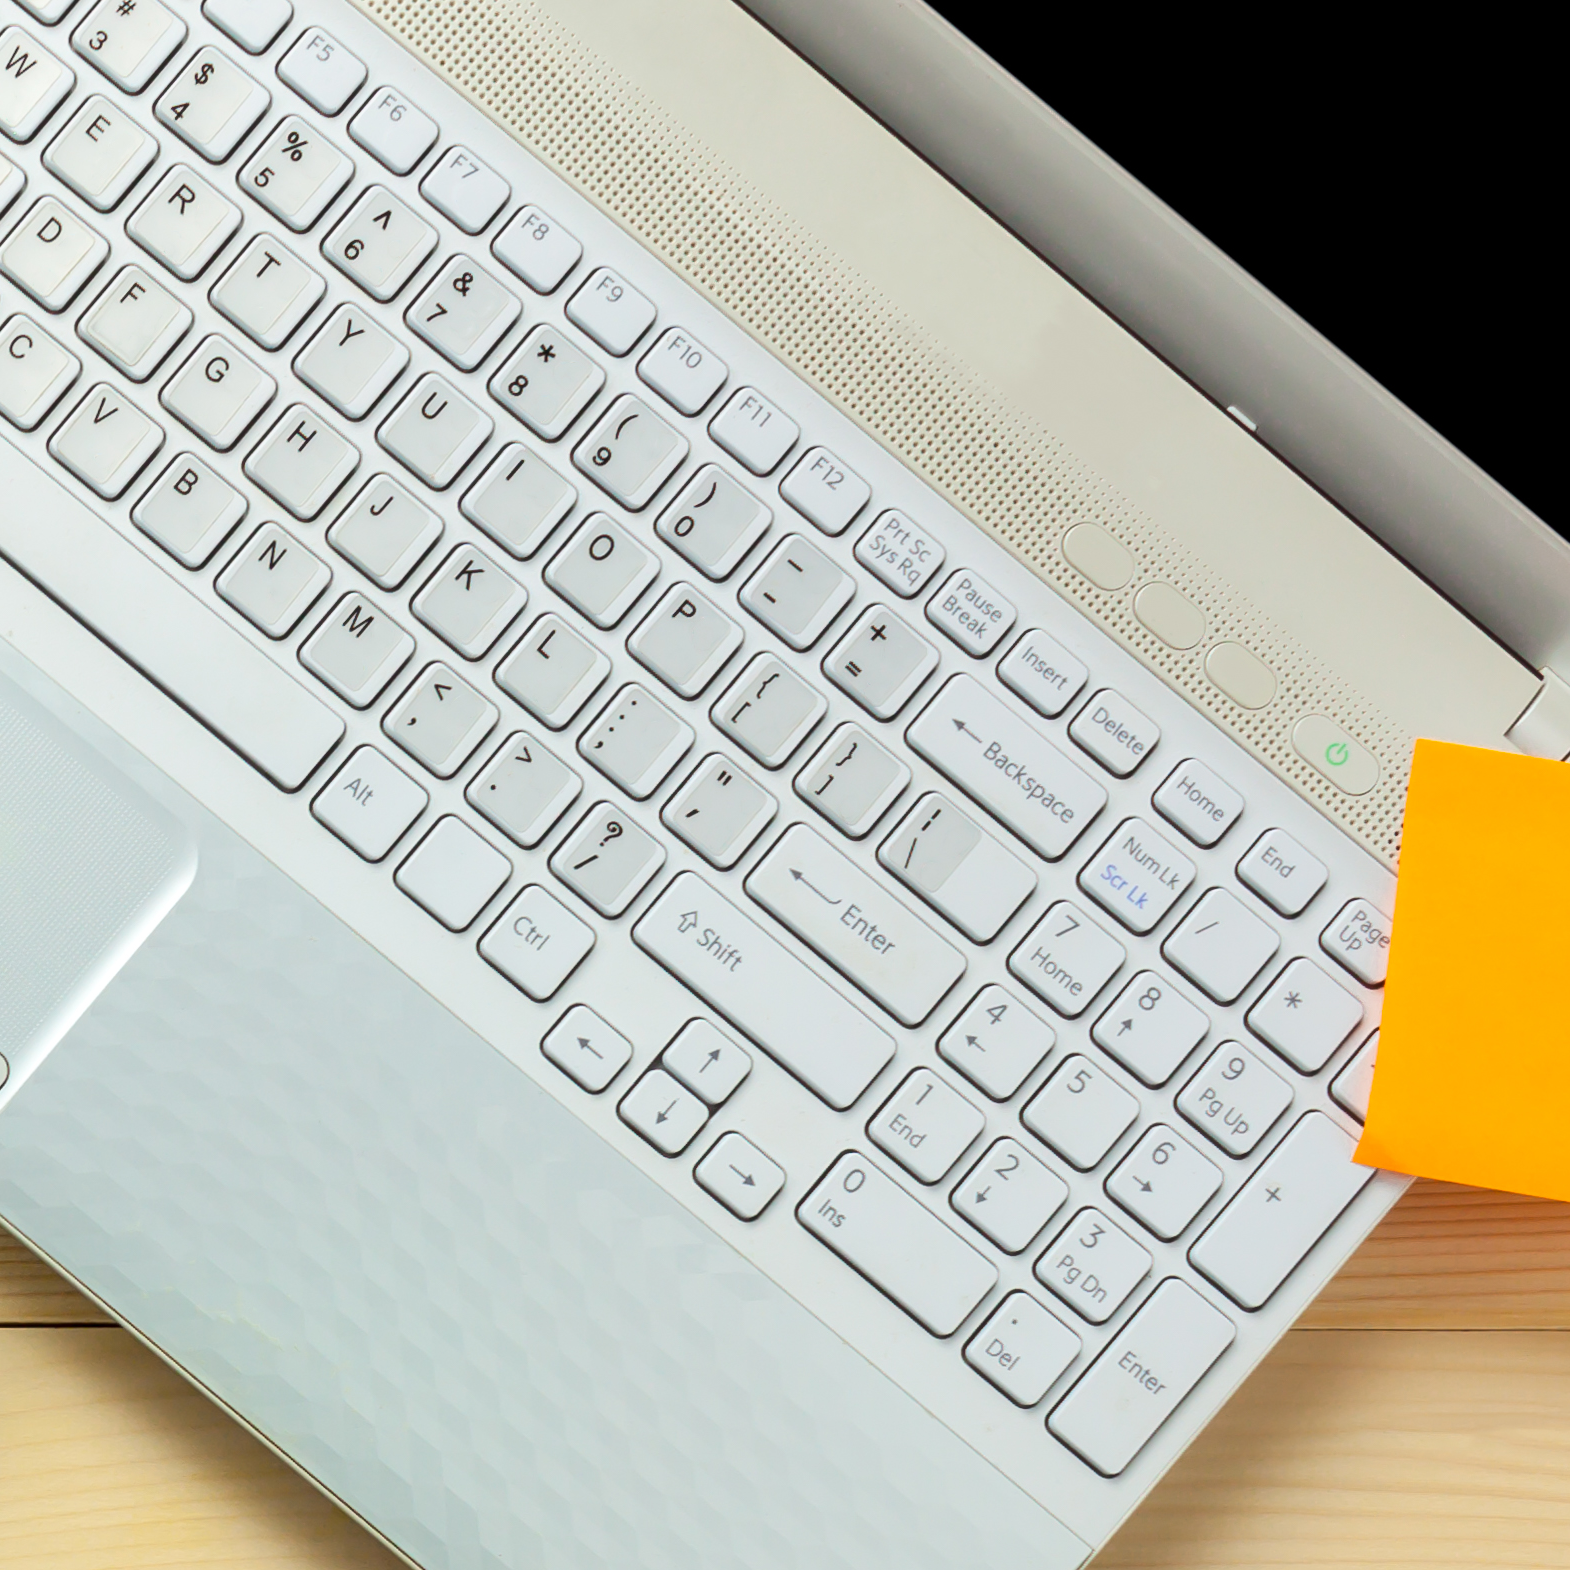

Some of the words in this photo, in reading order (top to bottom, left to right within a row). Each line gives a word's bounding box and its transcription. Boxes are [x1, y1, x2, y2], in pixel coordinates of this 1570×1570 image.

[88, 30, 108, 51] 3
[306, 35, 335, 62] F5
[5, 45, 38, 79] W
[194, 62, 215, 85] $
[170, 102, 190, 121] 4
[378, 95, 407, 122] F6
[85, 114, 111, 142] E
[281, 131, 309, 162] %
[253, 166, 275, 188] 5
[449, 154, 479, 179] F7
[167, 183, 196, 215] R
[36, 216, 63, 244] D
[521, 213, 550, 241] F8
[344, 239, 365, 261] 6
[256, 251, 282, 278] T
[119, 282, 146, 304] F
[452, 271, 474, 297] &
[596, 274, 624, 303] F9
[426, 302, 448, 323] 7
[8, 334, 33, 359] C
[338, 318, 366, 347] Y
[667, 336, 702, 369] F10
[204, 356, 230, 383] G
[507, 374, 529, 397] 8
[93, 397, 119, 424] V
[421, 391, 448, 420] U
[738, 396, 771, 428] F11
[286, 420, 318, 453] H
[505, 459, 525, 481] I
[592, 446, 612, 467] 9
[173, 468, 199, 496] B
[809, 454, 847, 491] F12
[369, 496, 394, 517] J
[673, 515, 695, 538] 0
[884, 518, 910, 545] Prt
[910, 538, 932, 563] Sc
[258, 539, 288, 571] N
[588, 533, 615, 561] O
[869, 535, 898, 564] Sys
[897, 557, 921, 587] Rq
[454, 559, 485, 591] K
[671, 598, 697, 618] P
[957, 577, 1003, 623] Pause
[341, 605, 374, 639] M
[942, 596, 987, 639] Break
[536, 629, 556, 660] L
[1022, 645, 1068, 691] Insert
[1092, 706, 1145, 756] Delete
[342, 778, 374, 807] Alt
[982, 742, 1074, 824] Backspace
[1177, 775, 1225, 822] Home
[599, 820, 624, 847] ?
[1122, 836, 1161, 875] Num
[1161, 866, 1180, 891] Lk
[1260, 845, 1296, 879] End
[1100, 864, 1129, 891] Scr
[1126, 885, 1149, 910] Lk
[513, 916, 550, 951] Ctrl
[839, 903, 896, 955] Enter
[1054, 914, 1081, 938] 7
[1339, 923, 1362, 951] Up
[1351, 910, 1391, 951] Page
[696, 928, 742, 972] Shift
[1031, 946, 1083, 996] Home
[1138, 986, 1162, 1011] 8
[985, 1004, 1008, 1025] 4
[1066, 1069, 1093, 1094] 5
[1221, 1057, 1246, 1081] 9
[915, 1083, 934, 1106] 1
[1198, 1087, 1224, 1118] Pg
[1223, 1107, 1250, 1136] Up
[888, 1113, 928, 1148] End
[994, 1153, 1020, 1181] 2
[1152, 1141, 1177, 1165] 6
[843, 1168, 866, 1194] 0
[817, 1198, 846, 1228] Ins
[1079, 1223, 1106, 1249] 3
[1055, 1254, 1082, 1285] Pg
[1079, 1275, 1108, 1304] Dn
[986, 1338, 1021, 1371] Del
[1117, 1350, 1167, 1395] Enter
